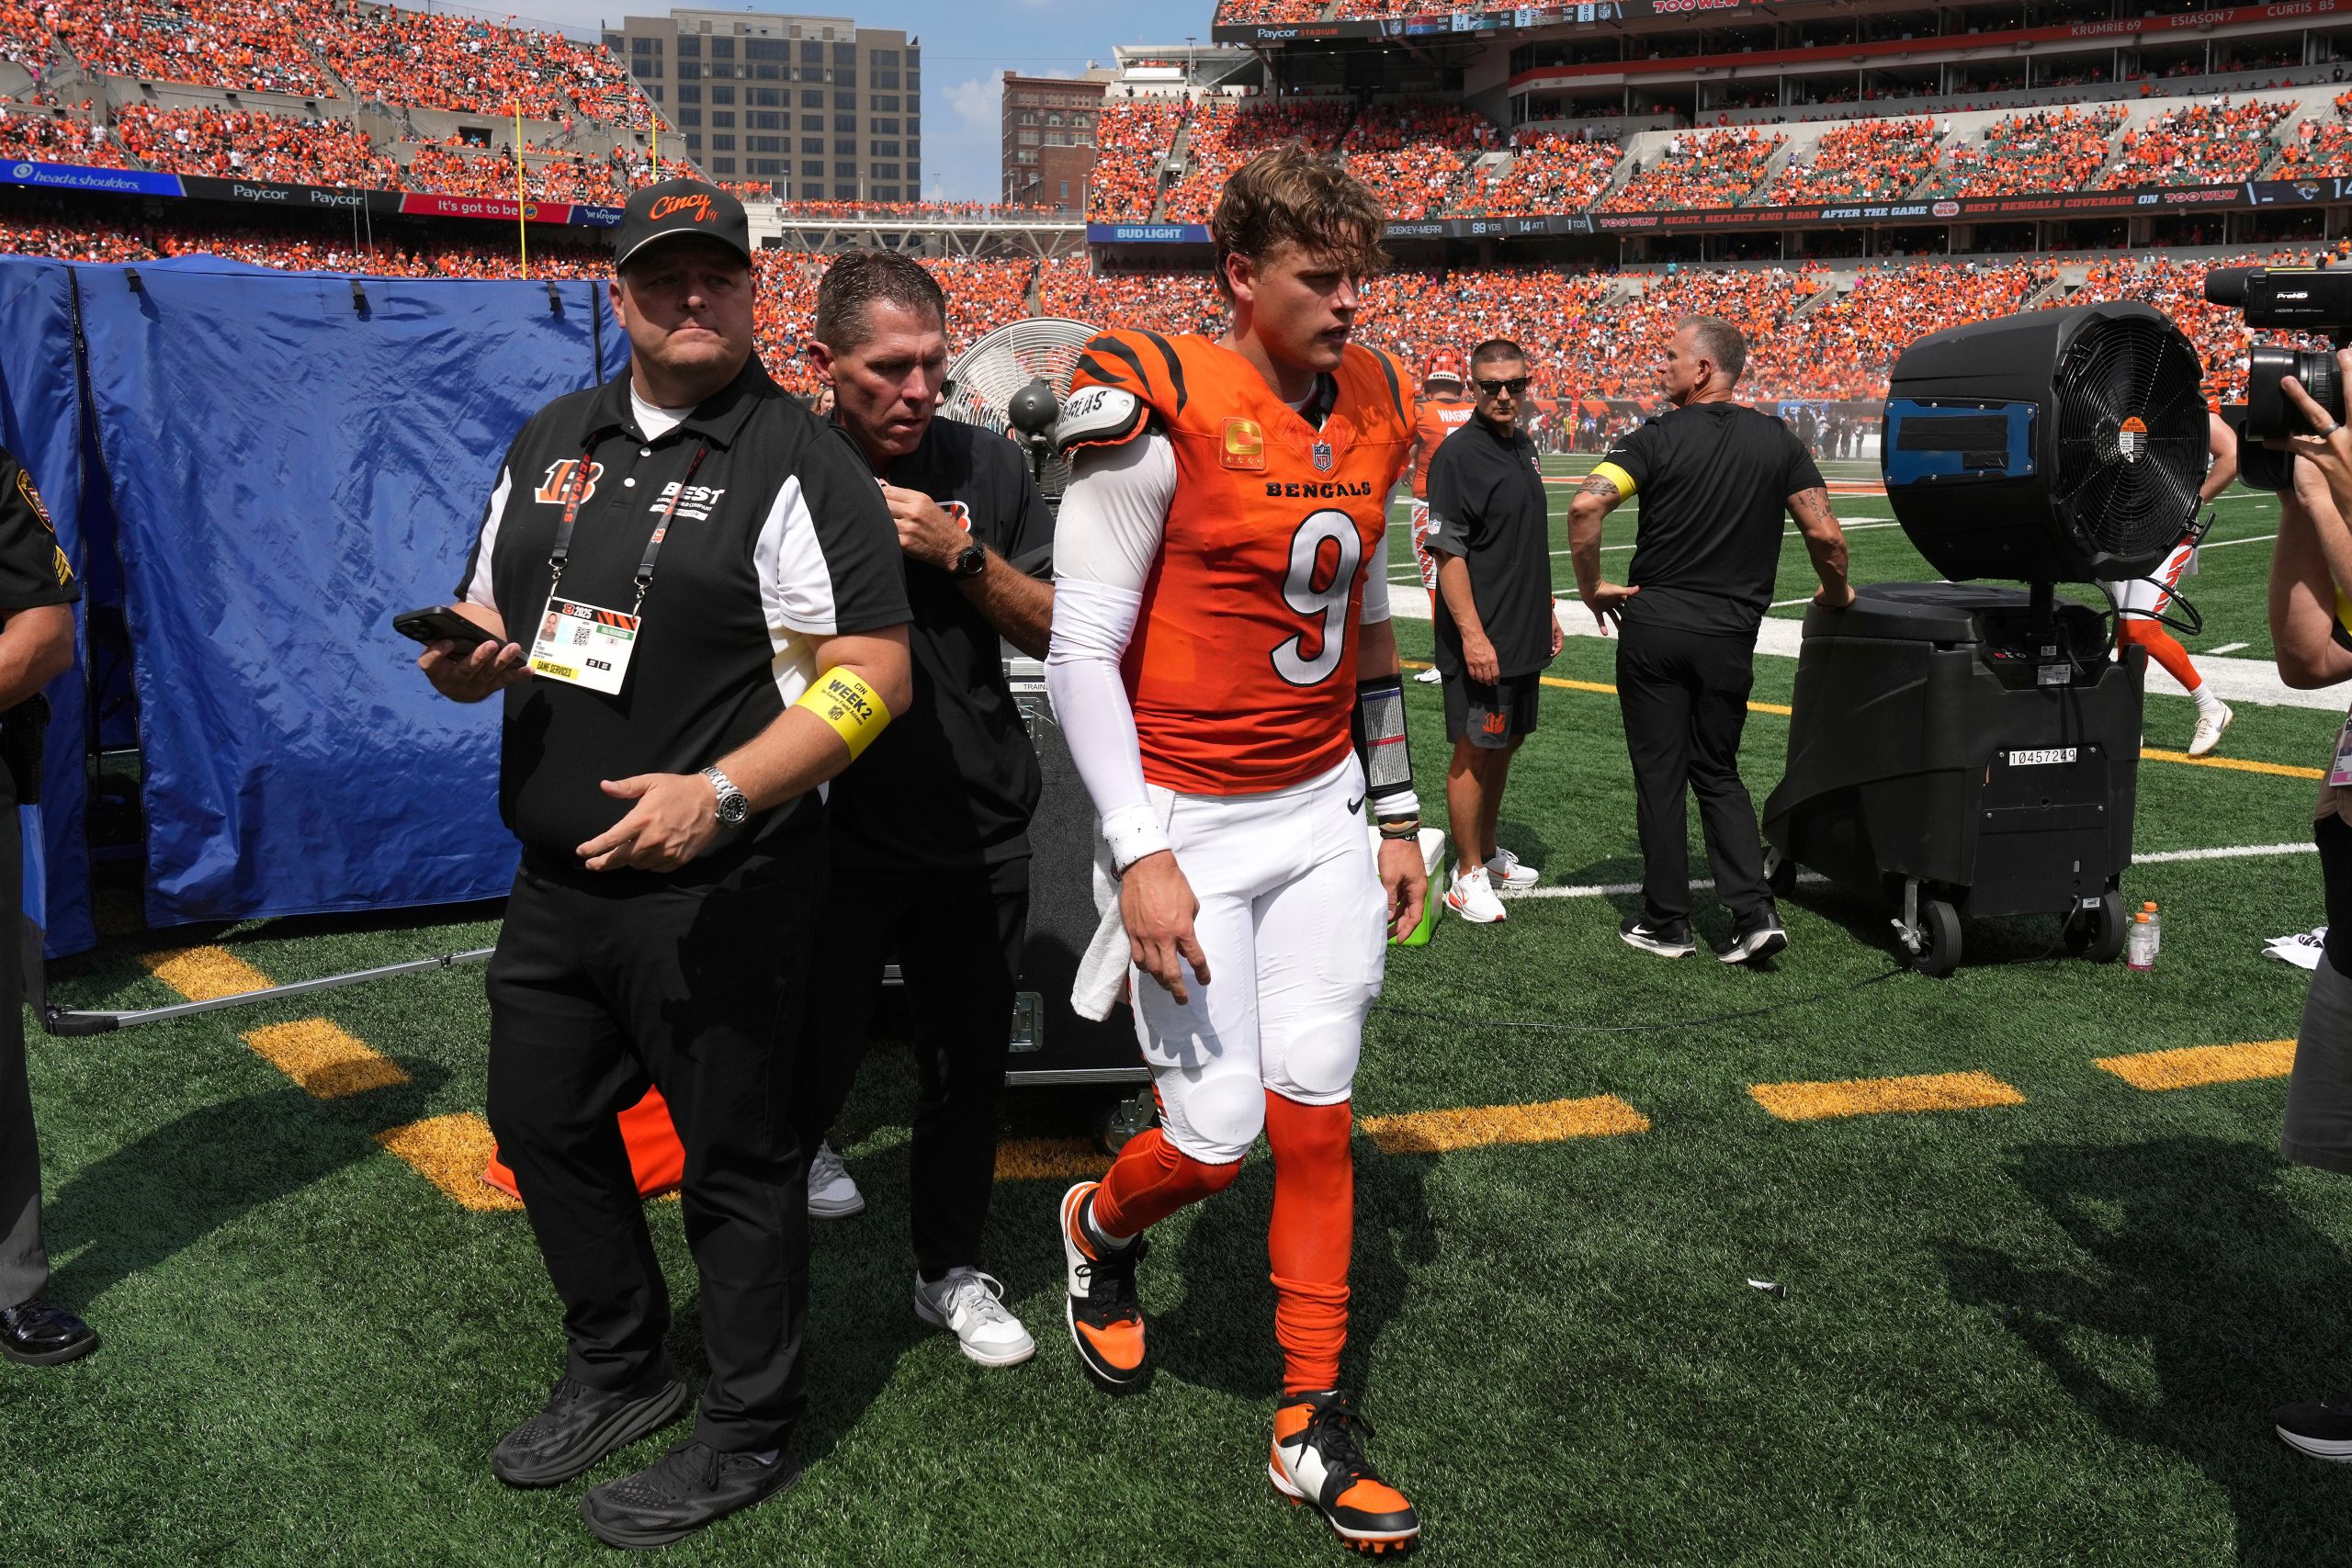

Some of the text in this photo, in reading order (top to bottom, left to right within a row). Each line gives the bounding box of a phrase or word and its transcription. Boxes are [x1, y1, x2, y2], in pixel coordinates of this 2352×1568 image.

[1519, 10, 1527, 18] 15
[1653, 0, 1695, 13] 700
[2267, 0, 2335, 17] CURTIS 85
[1583, 13, 1589, 21] 0
[2171, 11, 2234, 27] ESIASON 7
[1257, 28, 1339, 40] Paycor STADIUM
[2072, 20, 2142, 36] KRUMRIE 69
[78, 175, 139, 189] shoulders
[233, 185, 288, 201] Paycor
[311, 190, 363, 207] Paycor
[438, 200, 518, 216] It's got to be
[649, 194, 712, 222] Cincy
[1964, 202, 1997, 212] BEST
[2000, 197, 2061, 211] BENGALS
[2064, 195, 2135, 208] COVERAGE
[2137, 194, 2159, 205] ON
[597, 209, 621, 224] Kroger
[1705, 213, 1756, 223] REFLECT
[1758, 211, 1783, 221] AND
[1786, 210, 1819, 220] ROAR
[1821, 209, 1860, 219] AFTER
[1863, 207, 1887, 217] THE
[1891, 206, 1928, 216] GAME
[1472, 222, 1501, 233] 99 YDS
[1520, 221, 1544, 231] 14 ATT
[1567, 220, 1586, 230] 1 TDS
[1600, 218, 1628, 228] 700
[1117, 229, 1182, 238] BUD LIGHT
[1226, 422, 1262, 456] C
[662, 481, 726, 504] BEST
[1266, 481, 1372, 498] BENGALS
[1269, 508, 1363, 687] 9
[574, 606, 593, 619] 2025
[537, 660, 571, 678] GAME SERVICES
[854, 682, 867, 695] CIN
[828, 679, 873, 720] WEEK 2
[839, 700, 851, 713] Field
[849, 709, 864, 726] Access
[2011, 750, 2076, 764] 10457249
